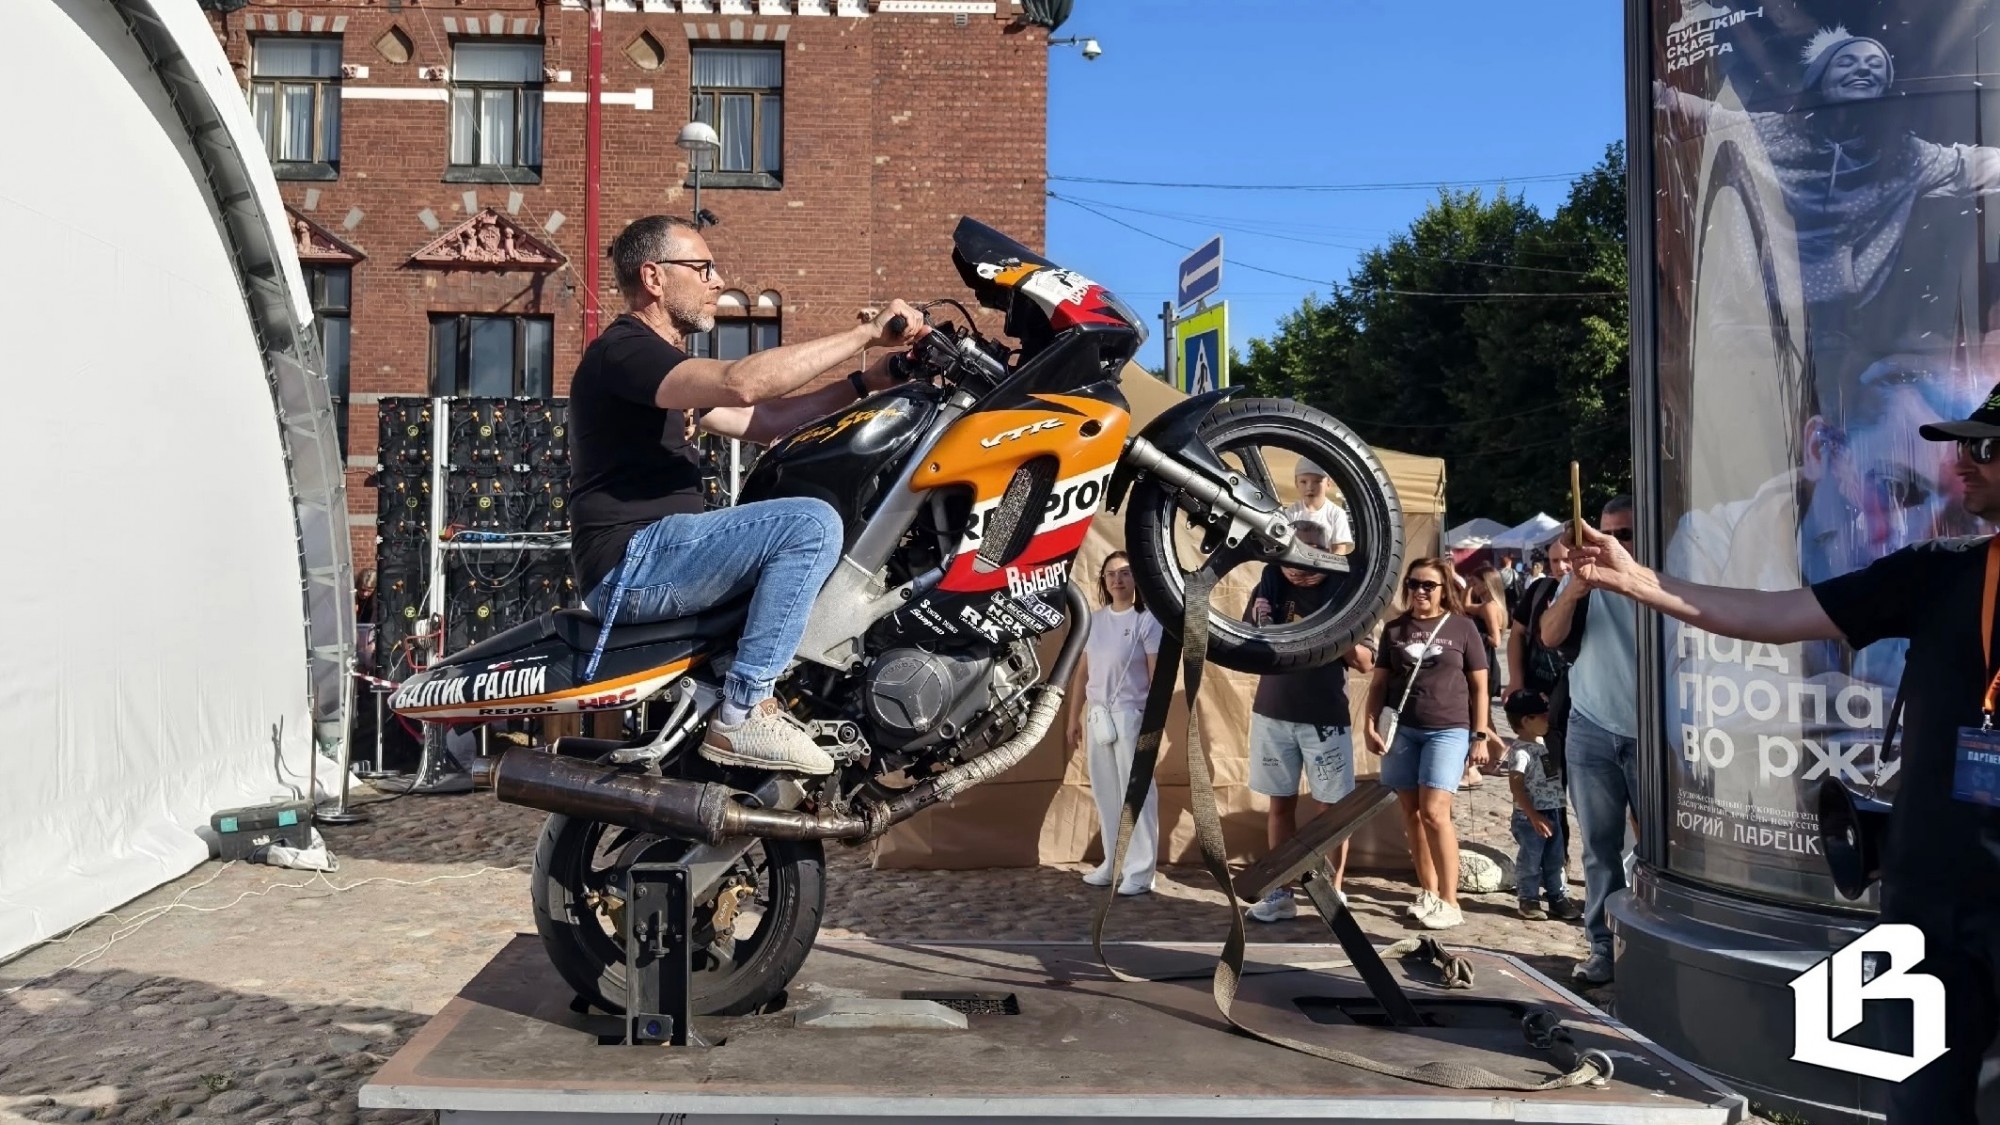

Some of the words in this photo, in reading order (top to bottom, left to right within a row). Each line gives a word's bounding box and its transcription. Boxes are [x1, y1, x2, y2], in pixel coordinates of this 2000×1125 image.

[1667, 6, 1763, 46] ПУШКИН
[1667, 32, 1715, 59] СКАЯ
[1667, 42, 1733, 74] КАРТА
[980, 417, 1066, 449] VTR
[960, 605, 1004, 641] RK
[987, 603, 1026, 636] NGK
[1006, 601, 1045, 631] MICHELIN
[1032, 602, 1061, 626] GAS
[395, 675, 470, 709] БАЛТИК
[473, 665, 547, 701] РАЛЛИ
[479, 706, 559, 716] REPSOL
[1681, 724, 1734, 769] во
[1676, 809, 1724, 839] ЮРИЙ
[1733, 823, 1824, 856] ЛАБЕЦК
